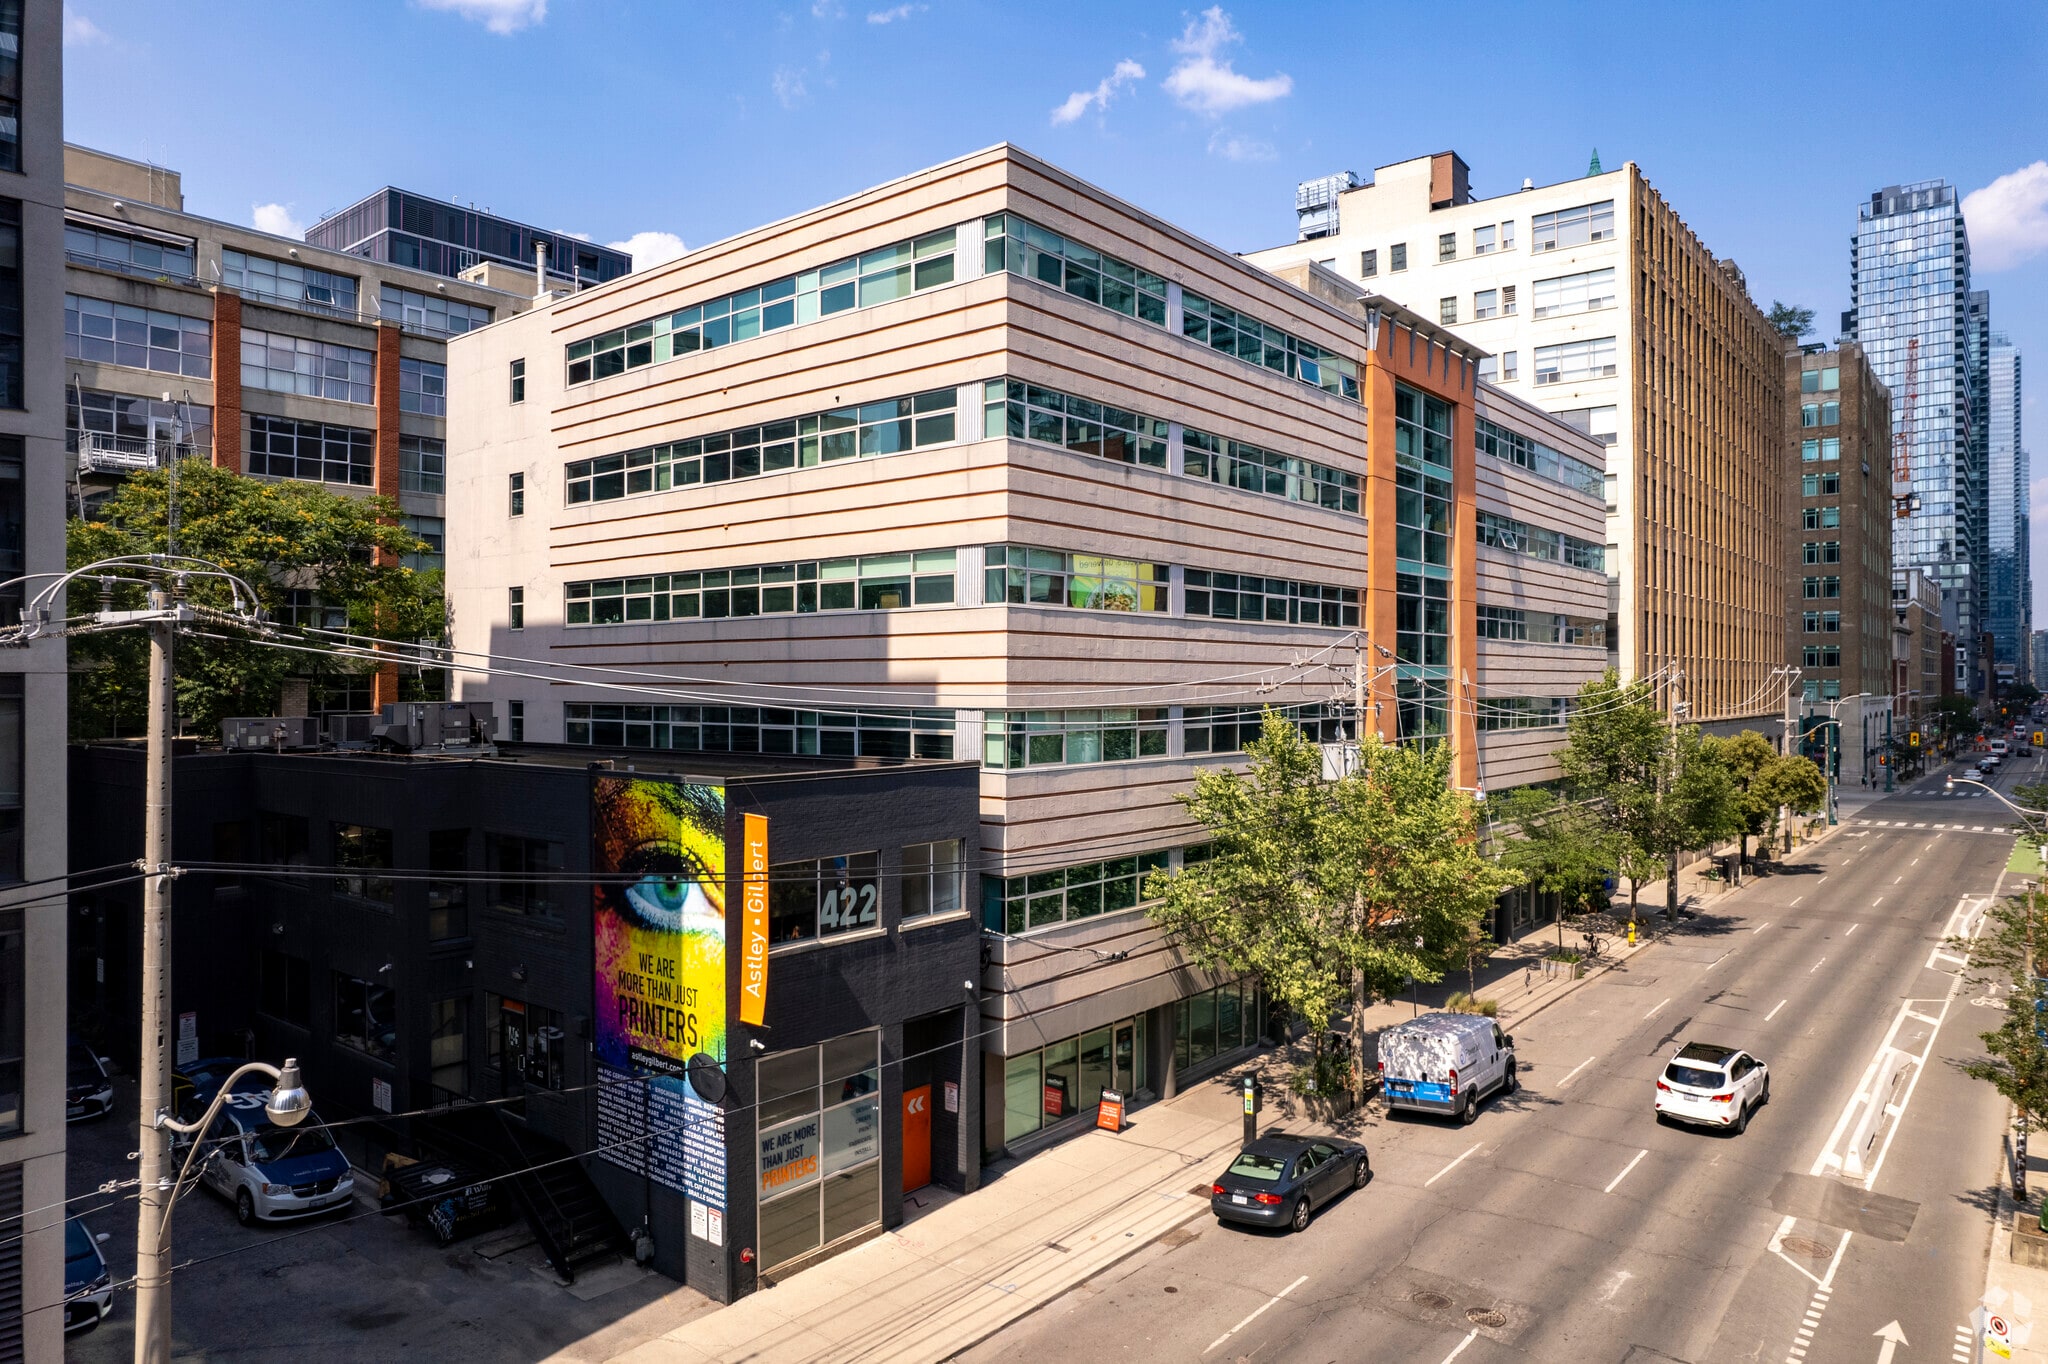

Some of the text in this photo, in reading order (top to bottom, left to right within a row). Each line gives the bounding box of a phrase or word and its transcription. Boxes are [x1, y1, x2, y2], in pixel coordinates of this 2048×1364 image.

[746, 841, 766, 998] Astley Gilbert
[820, 884, 876, 928] 422
[639, 952, 674, 979] WE ARE
[618, 970, 698, 1008] MORE THAN JUST
[618, 994, 697, 1047] PRINTERS
[632, 1052, 682, 1074] astleygilbert.com
[634, 1079, 651, 1090] PRINER
[655, 1086, 680, 1100] BROCHURES
[651, 1093, 669, 1104] VEHICLE
[670, 1099, 684, 1110] WRAPS
[637, 1104, 659, 1117] SOFWARE
[703, 1127, 724, 1141] DISPLAYS
[654, 1118, 668, 1129] DIRECT
[670, 1107, 694, 1122] MANUALS
[762, 1124, 816, 1152] WE ARE MORE
[854, 1146, 872, 1156] INSTALL
[652, 1149, 668, 1161] ONLINE
[693, 1165, 724, 1183] FULFILLMENT
[659, 1144, 682, 1158] MANAGED
[684, 1153, 698, 1165] PRINT
[700, 1160, 724, 1175] SERVICES
[762, 1144, 804, 1170] THAN JUST
[666, 1162, 697, 1180] DIMENSIONAL
[699, 1175, 724, 1191] LETTERING
[762, 1154, 817, 1191] PRINTERS
[688, 1188, 706, 1200] BRAILLE
